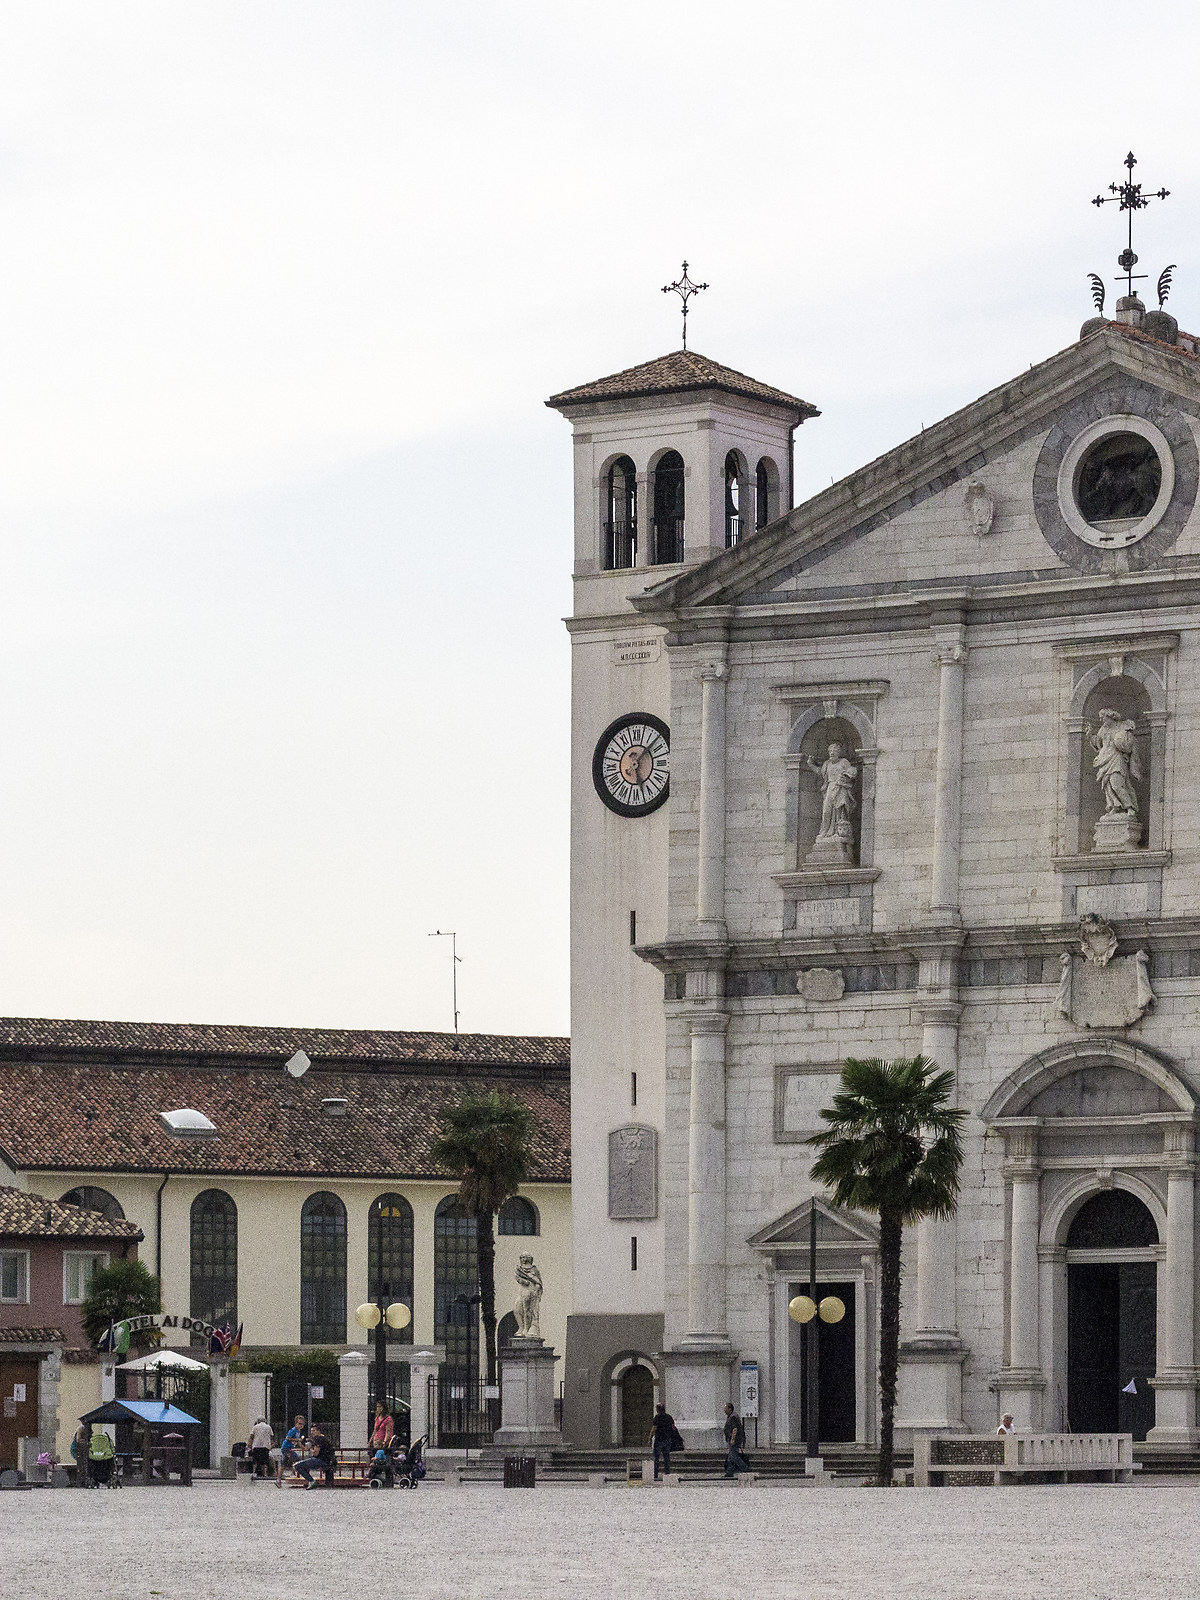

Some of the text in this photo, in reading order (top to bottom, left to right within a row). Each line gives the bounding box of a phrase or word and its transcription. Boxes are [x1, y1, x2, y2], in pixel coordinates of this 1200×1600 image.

[619, 734, 629, 747] XI
[632, 729, 642, 742] XII
[610, 747, 620, 757] X
[654, 744, 663, 753] II
[162, 1315, 178, 1328] AI
[181, 1316, 215, 1338] DOG
